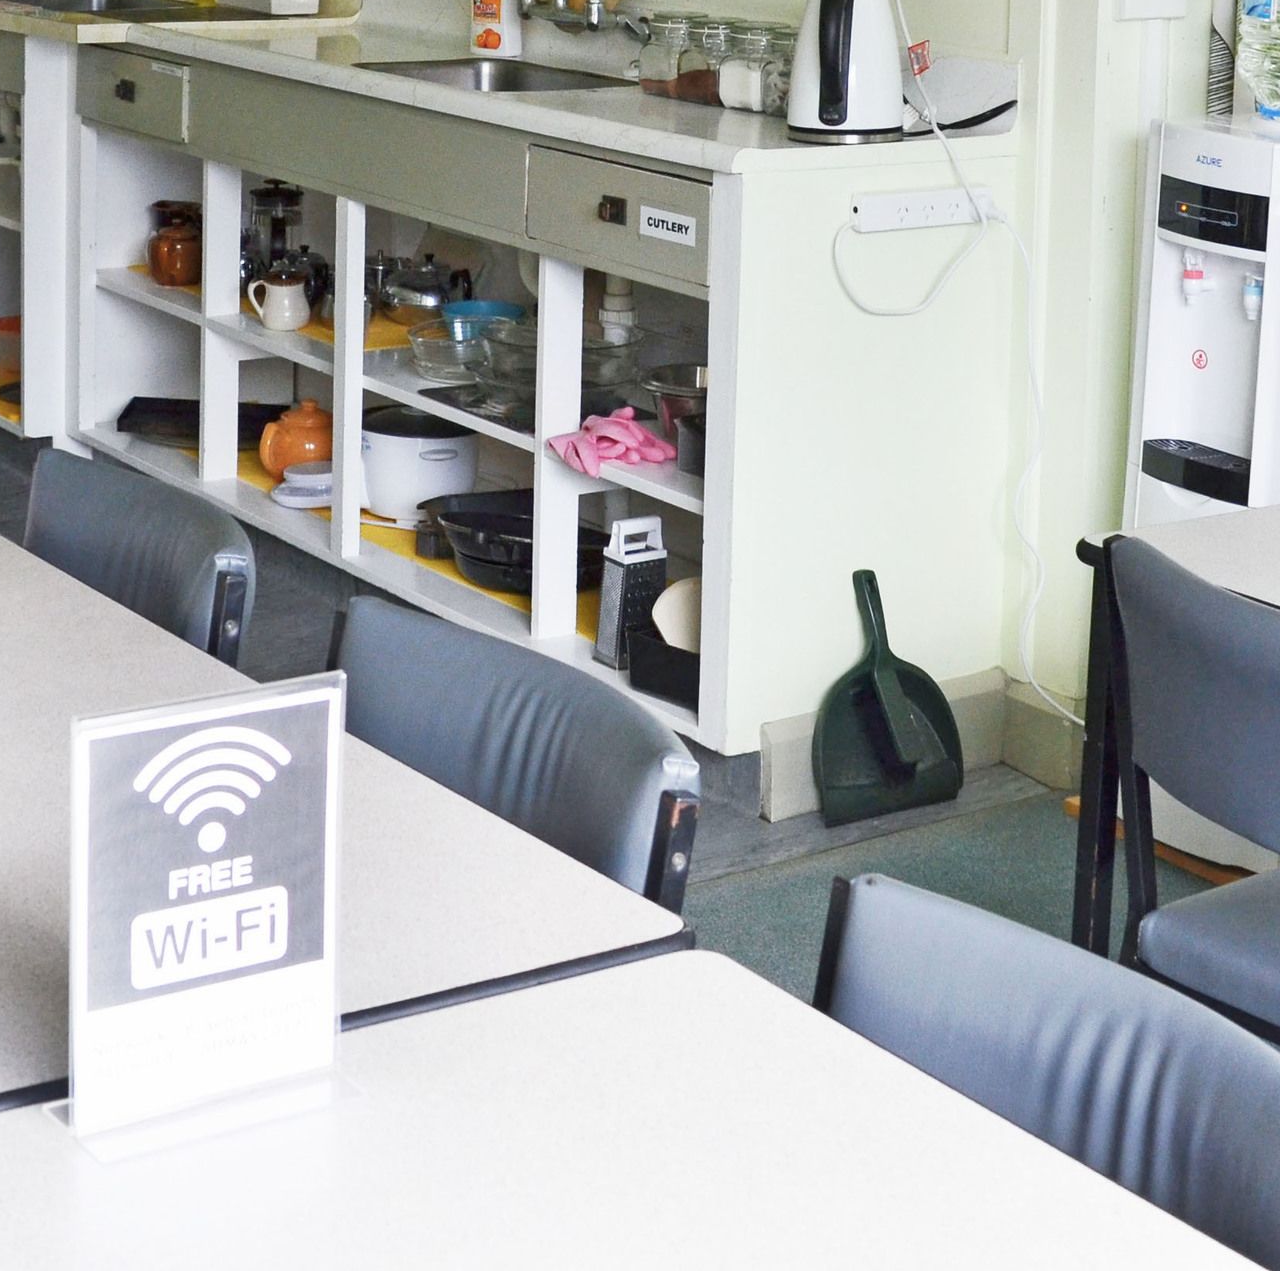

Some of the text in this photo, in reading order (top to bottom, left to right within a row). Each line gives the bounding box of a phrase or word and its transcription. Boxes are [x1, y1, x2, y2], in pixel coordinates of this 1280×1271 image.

[1196, 155, 1222, 168] AZURE
[647, 216, 690, 236] CUTLERY
[168, 855, 254, 900] FREE
[145, 902, 275, 969] Wi-Fi
